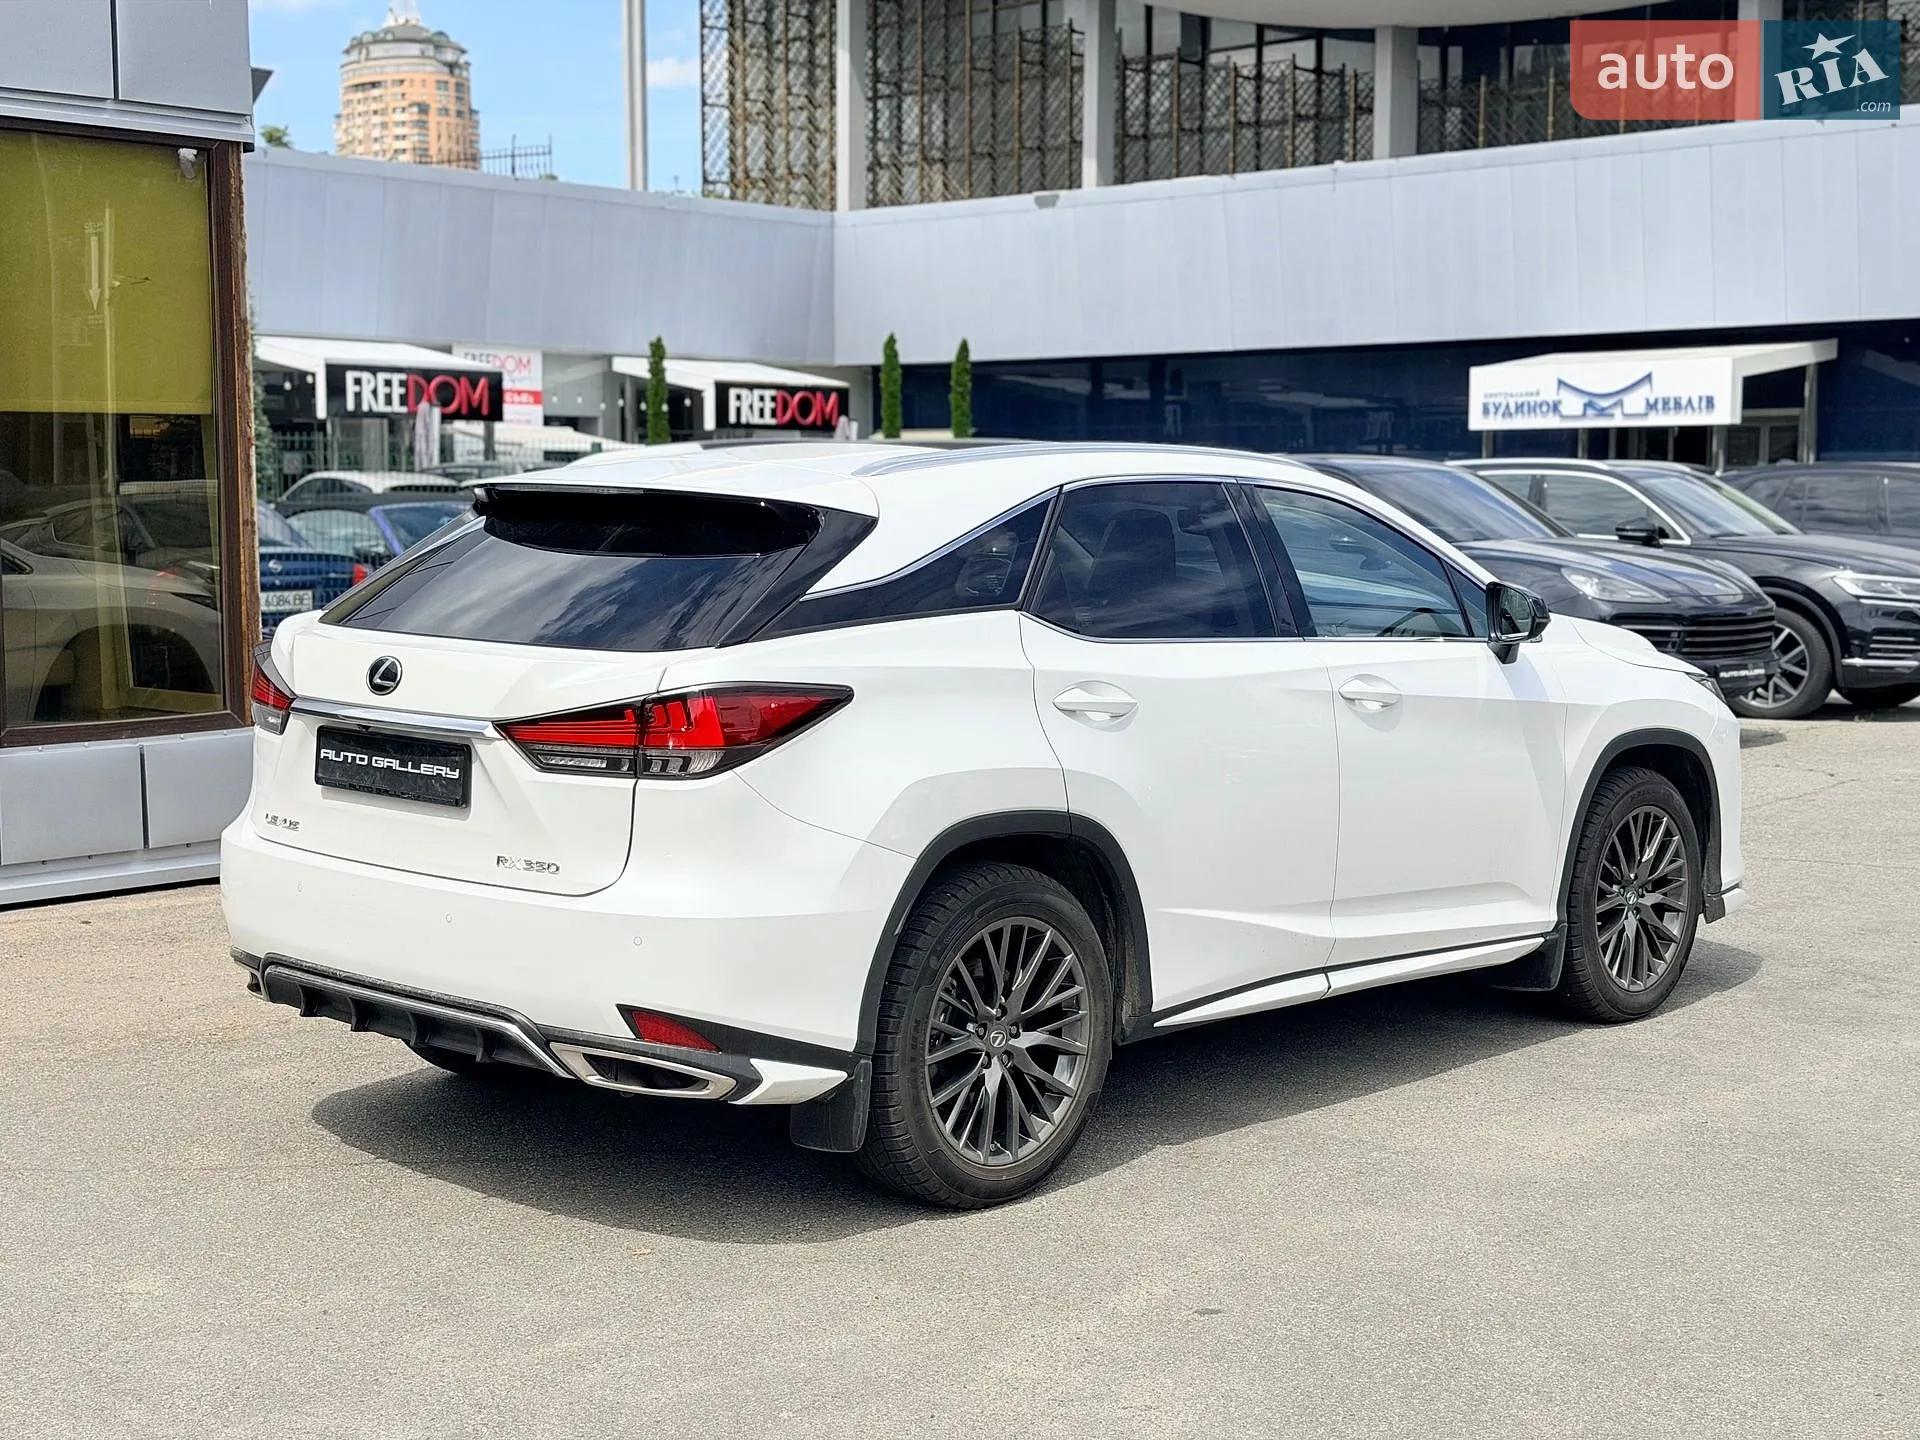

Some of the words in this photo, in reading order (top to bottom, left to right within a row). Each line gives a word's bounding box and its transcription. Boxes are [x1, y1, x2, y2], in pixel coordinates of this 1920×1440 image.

[345, 370, 490, 416] FREEDOM
[728, 387, 840, 427] FREEDOM
[1482, 400, 1562, 419] БУДИНОК
[320, 748, 368, 765] AUTO
[371, 756, 460, 779] GALLERY
